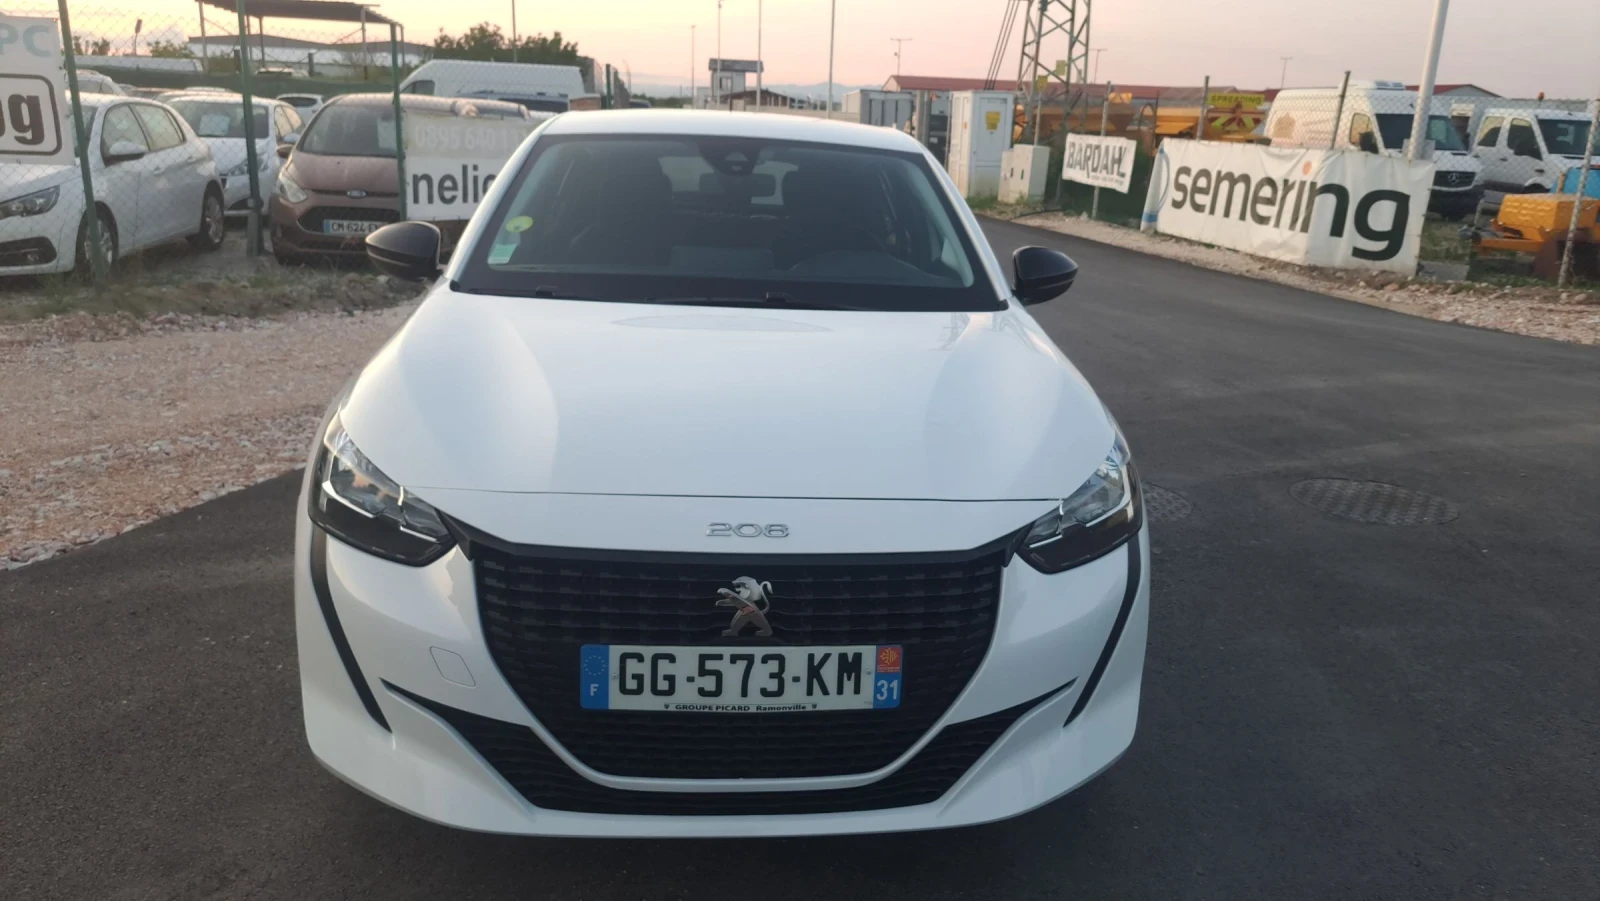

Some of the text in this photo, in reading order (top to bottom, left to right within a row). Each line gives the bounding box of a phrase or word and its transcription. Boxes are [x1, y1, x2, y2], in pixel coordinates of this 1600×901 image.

[1171, 160, 1411, 261] semering
[706, 522, 789, 538] 208
[619, 652, 862, 698] GG-573-KM
[590, 683, 599, 696] F
[876, 679, 898, 700] 31
[675, 704, 714, 712] GROUPE
[756, 704, 806, 712] Ramonville
